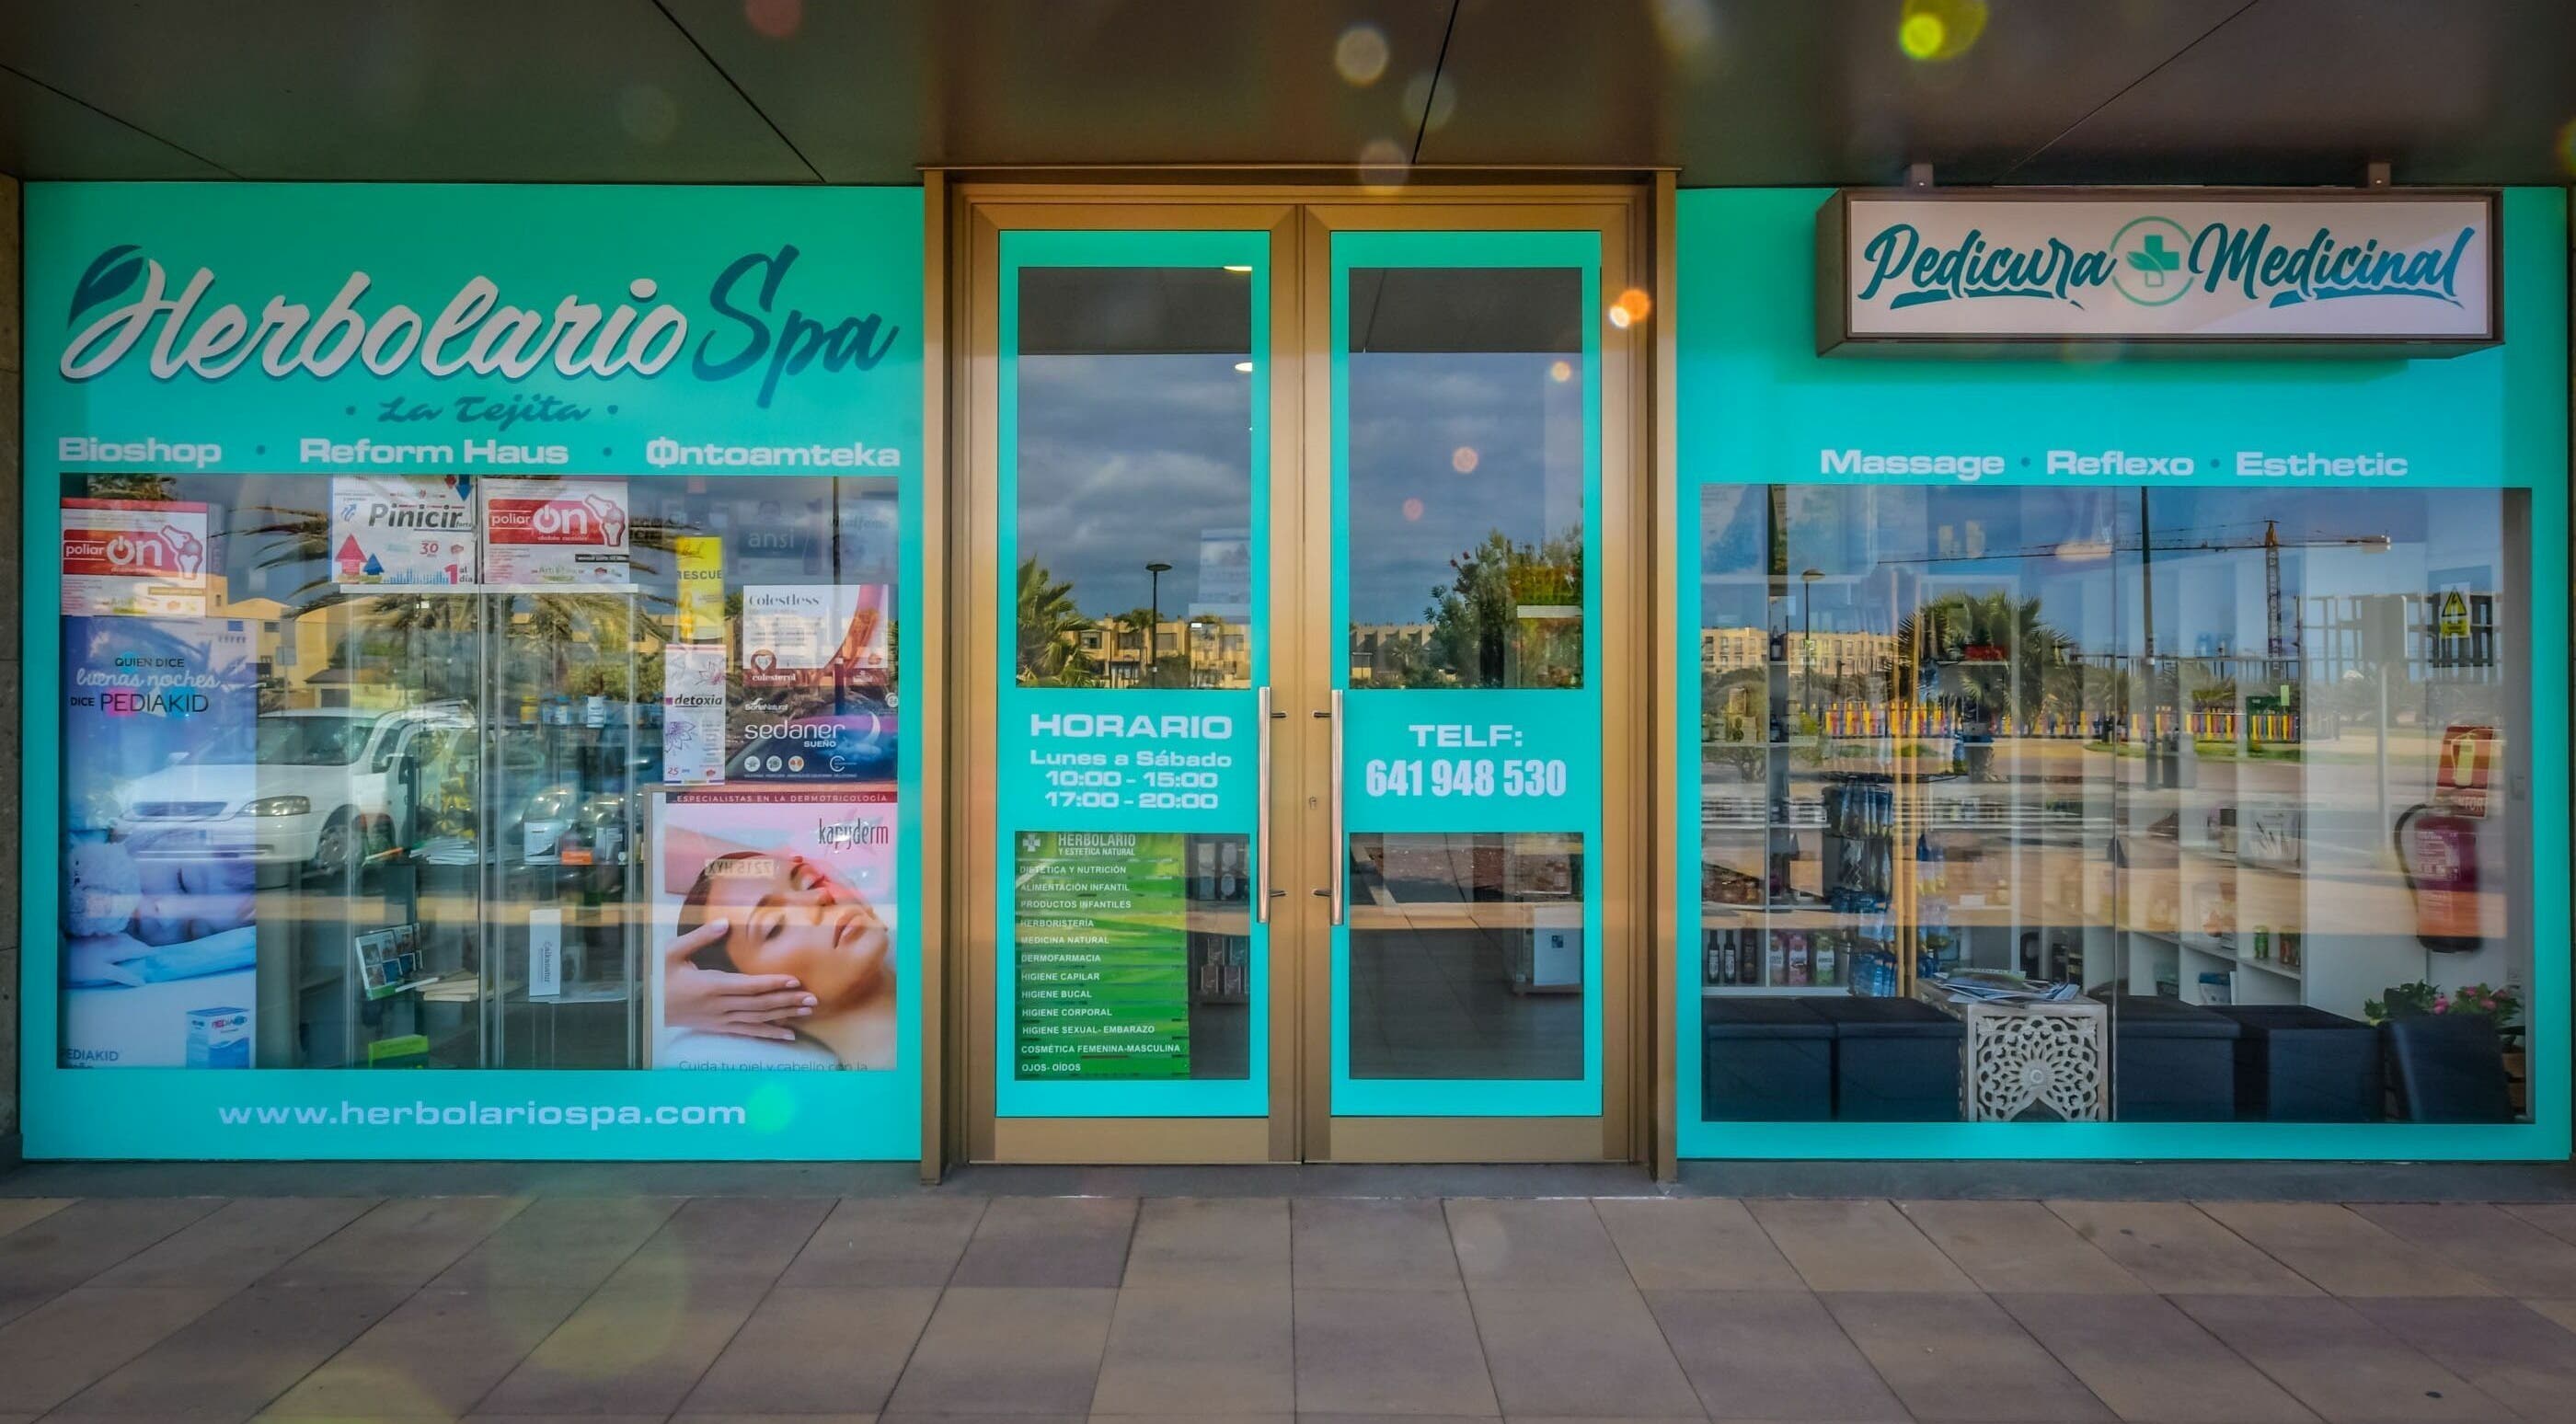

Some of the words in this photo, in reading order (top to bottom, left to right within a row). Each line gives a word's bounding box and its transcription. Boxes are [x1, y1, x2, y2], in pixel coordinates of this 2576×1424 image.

[1857, 223, 2116, 304] Pedicura
[2189, 223, 2476, 304] Medicinal
[59, 257, 689, 382] Herbolario
[692, 244, 900, 408] Spa
[377, 396, 443, 423] La
[454, 394, 592, 432] Tejita
[59, 437, 222, 468] Bioshop
[300, 438, 454, 464] Reform
[464, 439, 569, 465] Haus
[1820, 449, 2005, 481] Massage
[2046, 450, 2195, 477] Reflexo
[2237, 452, 2409, 477] Esthetic
[368, 502, 463, 528] Pinicir
[115, 658, 153, 668] QUIEN
[155, 658, 185, 668] DICE
[70, 696, 95, 706] DICE
[100, 694, 209, 712] PEDIAKID
[673, 694, 723, 706] detoxia
[744, 719, 845, 740] sedaner
[1030, 714, 1233, 740] HORARIO
[1409, 724, 1523, 747] TELF:
[803, 739, 836, 748] SUEÑO
[1030, 750, 1107, 765] Lunes
[1114, 752, 1129, 766] a
[1136, 750, 1233, 767] Sábado
[1045, 770, 1122, 787] 10:00
[1143, 772, 1219, 788] 15:00
[1366, 759, 1422, 797] 641
[1432, 759, 1495, 797] 948
[1503, 759, 1567, 797] 530
[676, 794, 753, 802] ESPECIALISTAS
[756, 794, 769, 802] EN
[774, 794, 787, 802] LA
[1044, 791, 1120, 808] 17:00
[1138, 792, 1219, 809] 20:00
[1058, 833, 1136, 847] HERBOLARIO
[1058, 847, 1064, 856] Y
[1102, 848, 1136, 856] NATURAL
[1068, 866, 1075, 874] Y
[1089, 883, 1130, 891] INFANTIL
[1020, 901, 1077, 909] PRODUCTOS
[1079, 900, 1132, 909] INFANTILES
[1020, 936, 1064, 945] MEDICINA
[1067, 936, 1110, 945] NATURAL
[1021, 954, 1101, 962] DERMOFARMACIA
[1021, 972, 1058, 981] HIGIENE
[1060, 972, 1100, 981] CAPILAR
[1021, 990, 1058, 999] HIGIENE
[1061, 990, 1092, 999] BUCAL
[1022, 1008, 1059, 1016] HIGIENE
[1061, 1008, 1112, 1016] CORPORAL
[1022, 1026, 1059, 1035] HIGIENE
[1103, 1026, 1156, 1034] EMBARAZO
[1077, 1044, 1180, 1053] FEMENINA-MASCULINA
[218, 1100, 747, 1131] www.herbolariospa.com
